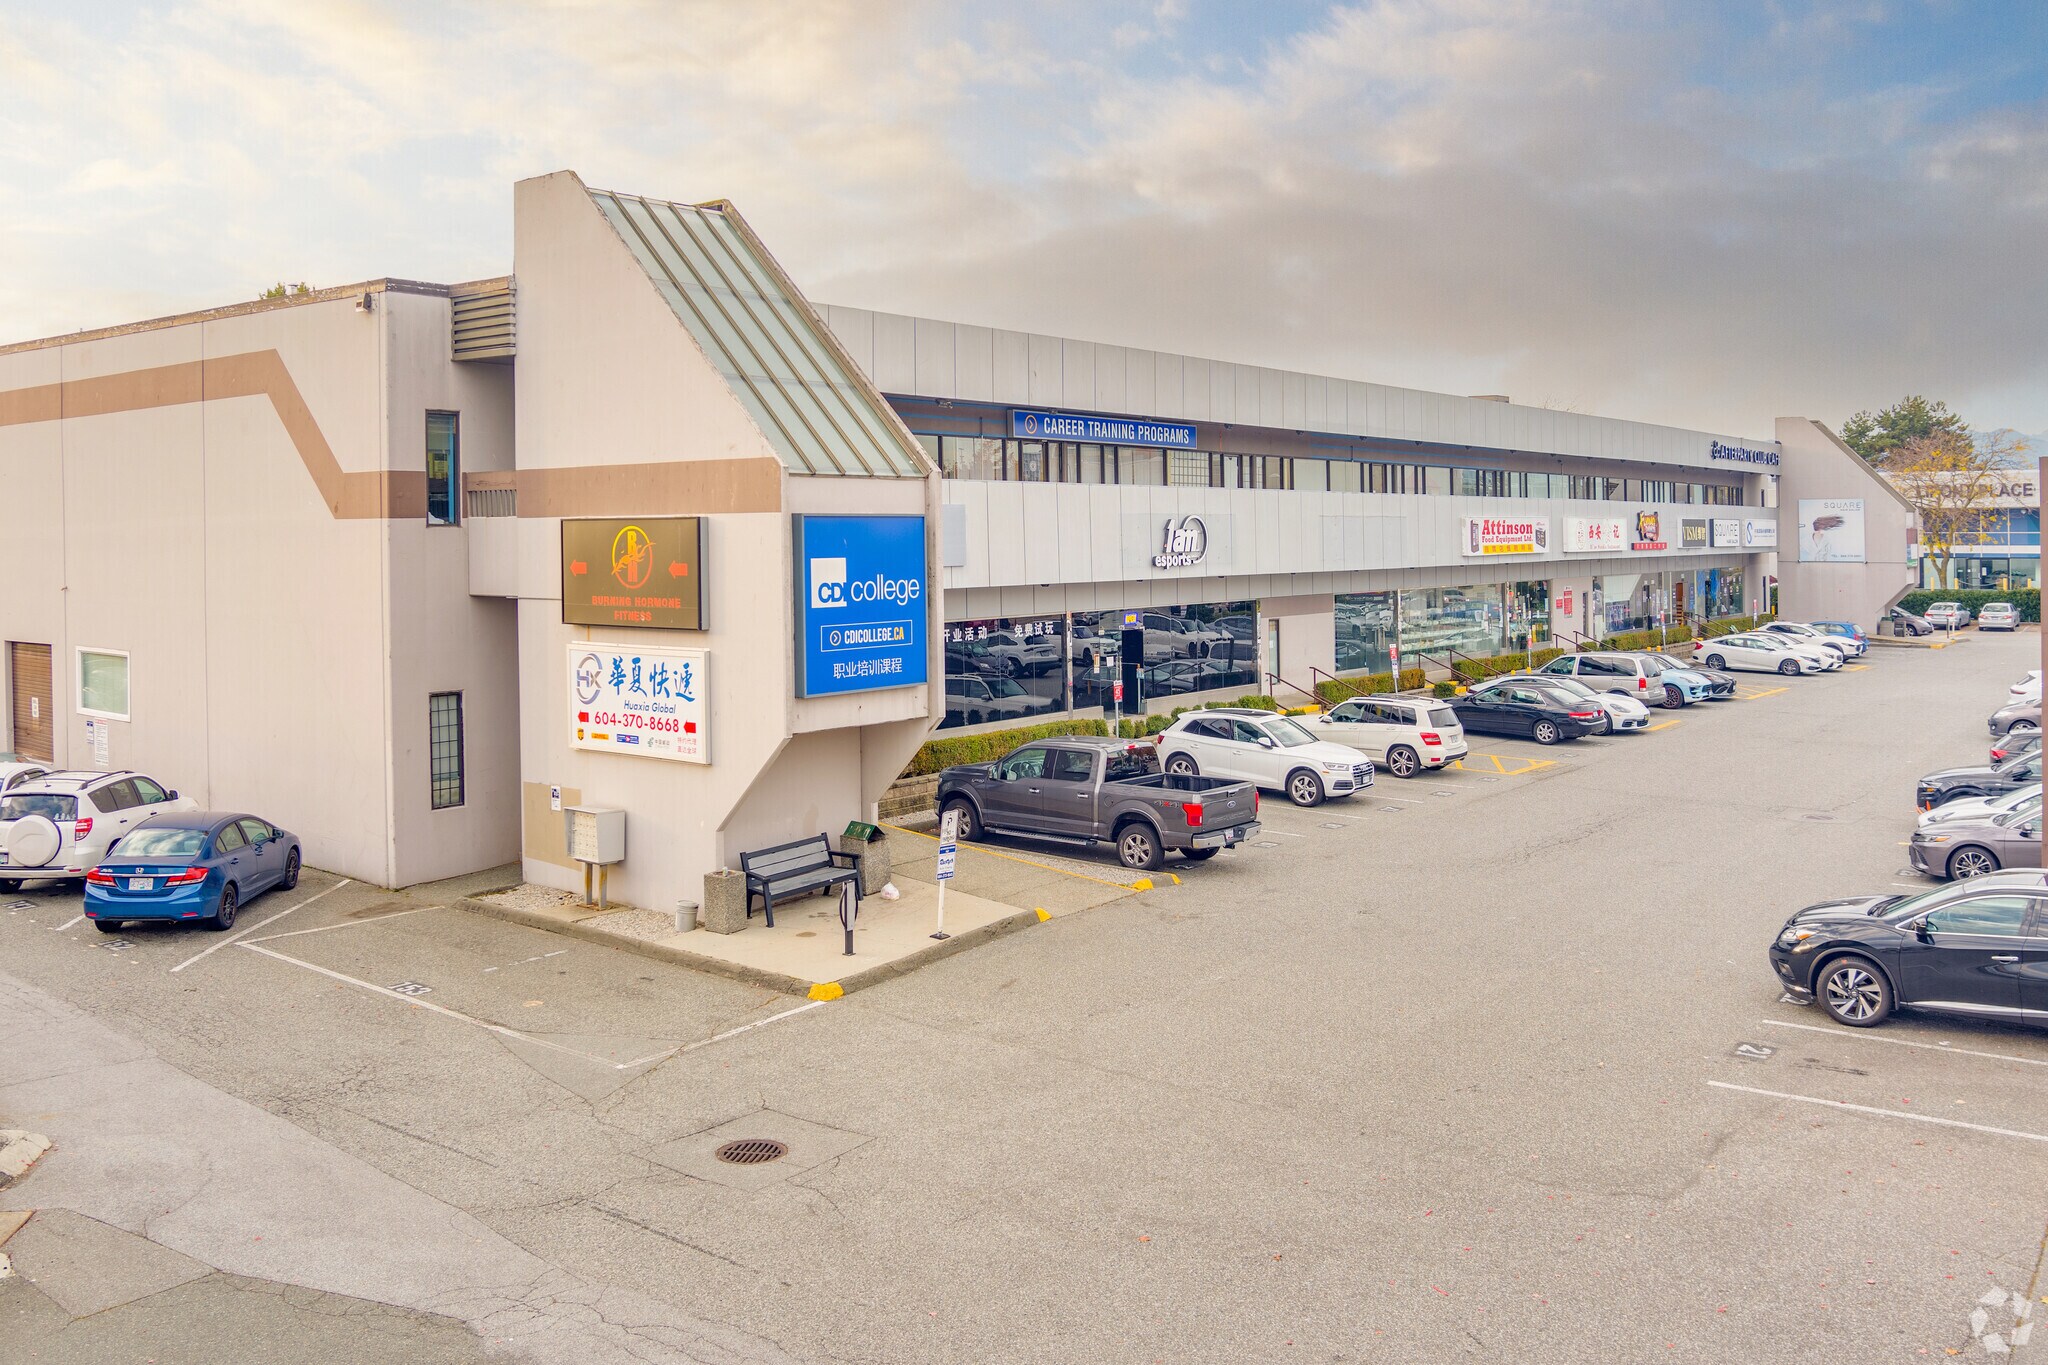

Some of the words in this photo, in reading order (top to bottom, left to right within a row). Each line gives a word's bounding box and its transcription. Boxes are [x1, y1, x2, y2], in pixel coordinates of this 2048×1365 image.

[1043, 417, 1085, 436] CAREER
[1088, 421, 1135, 440] TRAINING
[1138, 424, 1189, 444] PROGRAMS
[1482, 519, 1533, 535] Attinson
[1496, 535, 1522, 544] Equipment
[1153, 553, 1192, 569] esports
[851, 574, 920, 606] college
[591, 595, 632, 606] BURNING
[635, 597, 681, 609] HORMONE
[614, 610, 652, 622] FITNESS
[844, 627, 904, 644] CDICOLLEGE.CA
[833, 658, 903, 679] 职业培训课程
[624, 700, 650, 712] Huaxia
[652, 702, 677, 714] Global
[594, 711, 679, 733] 604-370-8668
[387, 981, 433, 996] 153
